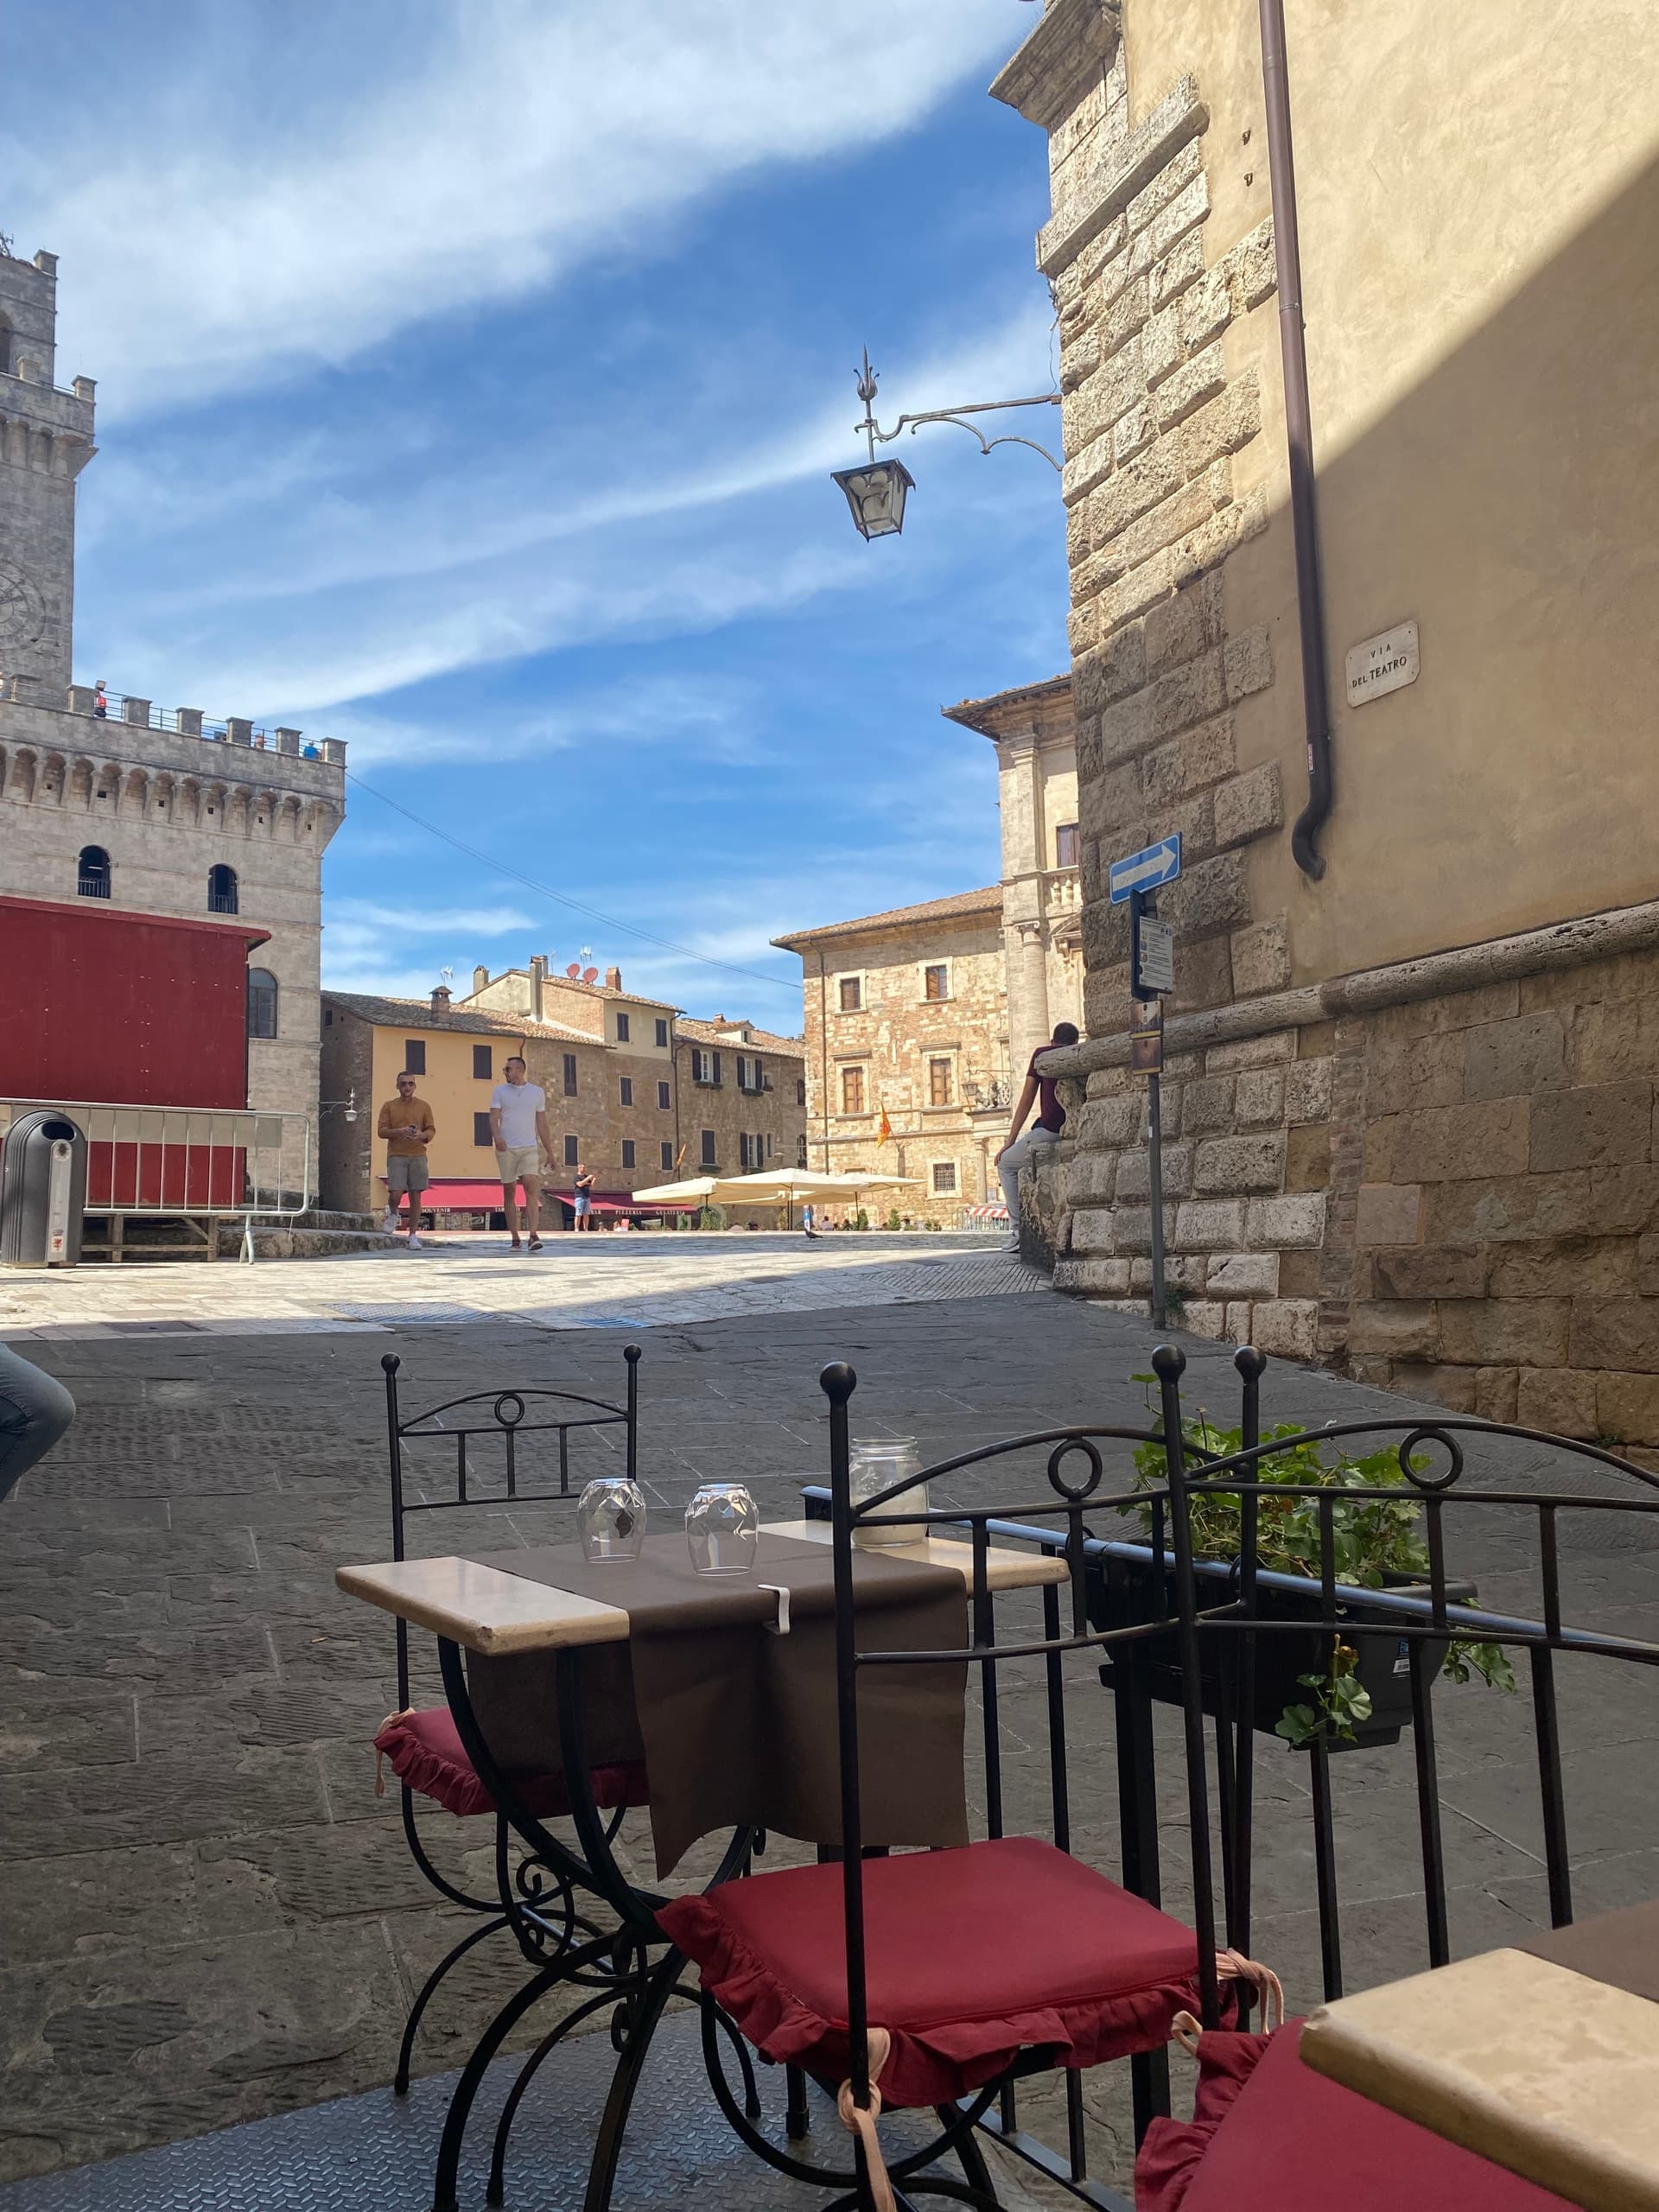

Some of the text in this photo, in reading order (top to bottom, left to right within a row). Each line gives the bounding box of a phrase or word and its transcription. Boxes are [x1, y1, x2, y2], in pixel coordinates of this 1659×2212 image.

[1370, 644, 1391, 658] VIA
[1352, 657, 1407, 688] DEL TEATRO
